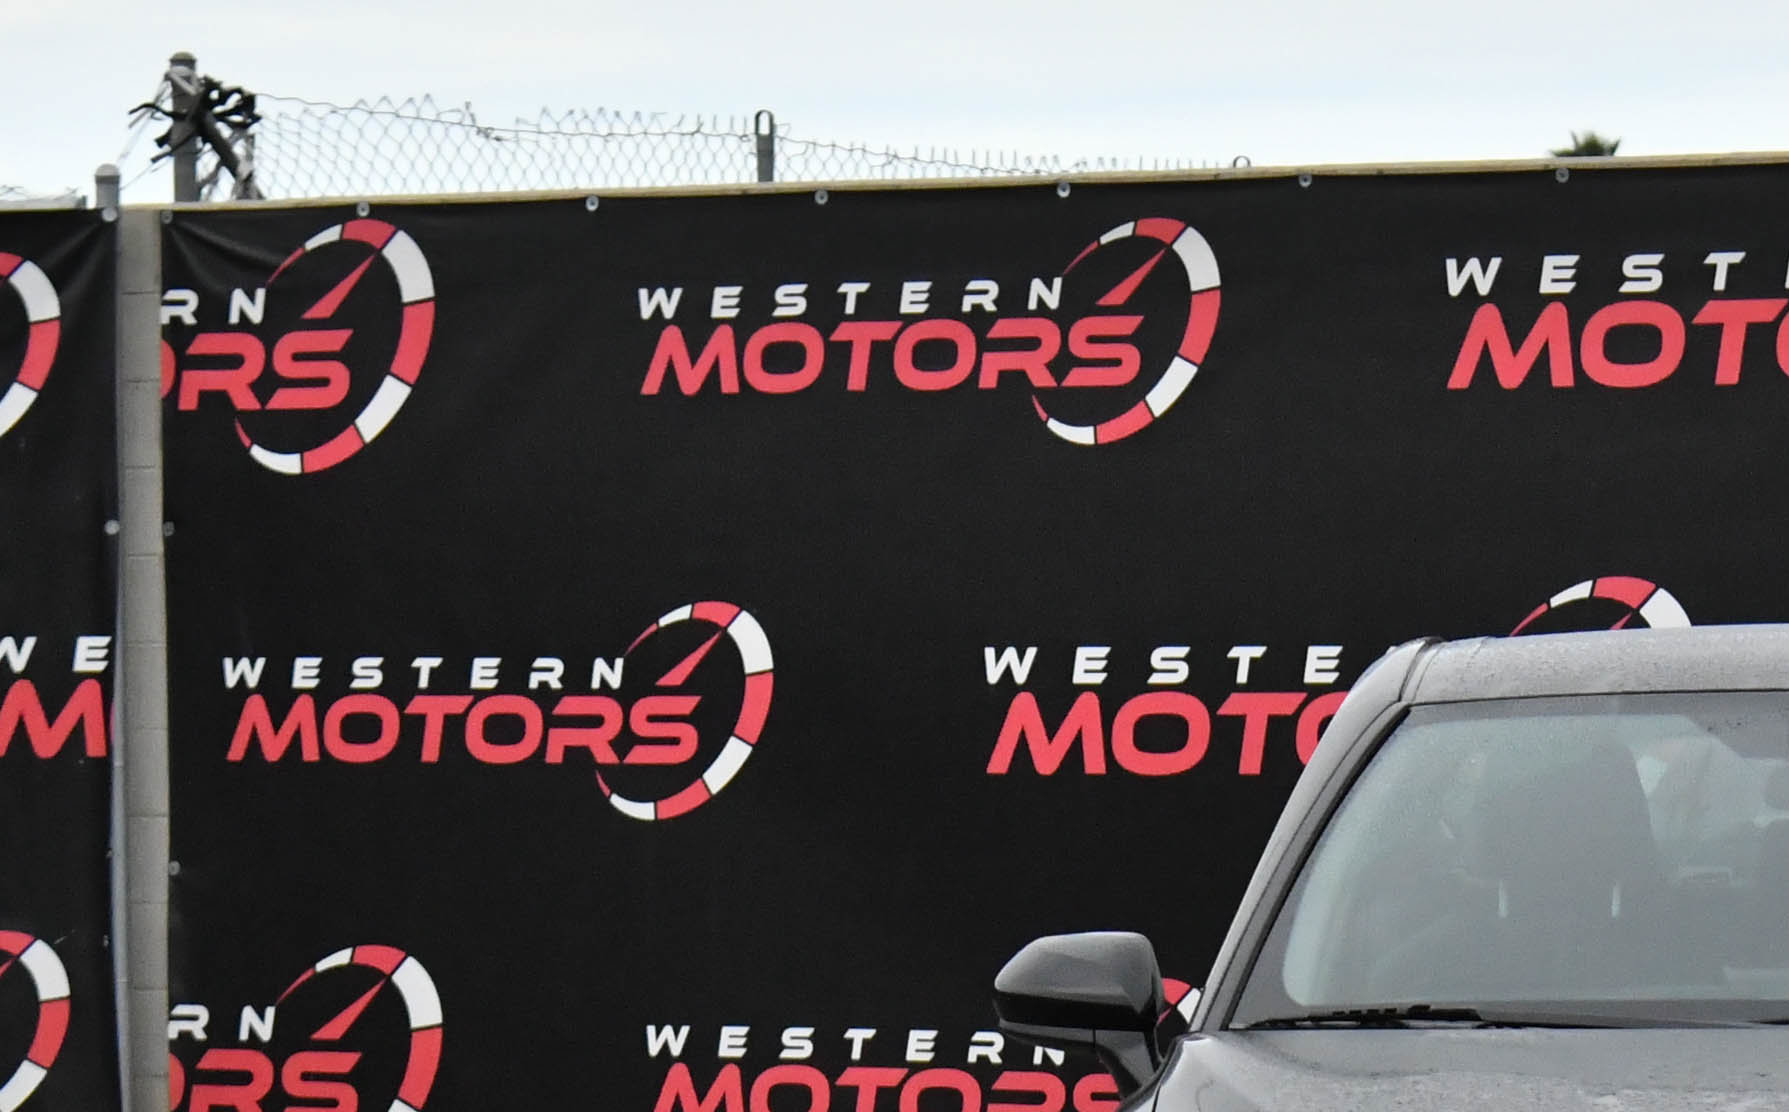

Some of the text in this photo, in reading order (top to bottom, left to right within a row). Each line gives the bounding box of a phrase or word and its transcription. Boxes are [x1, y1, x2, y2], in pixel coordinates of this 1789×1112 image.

[638, 276, 1063, 320] WESTERN
[640, 315, 1144, 396] MOTORS
[223, 656, 625, 690] WESTERN
[984, 645, 1344, 685] WESTE
[227, 693, 702, 765] MOTORS
[986, 690, 1350, 776] MOT
[646, 1024, 1065, 1066] WESTERN
